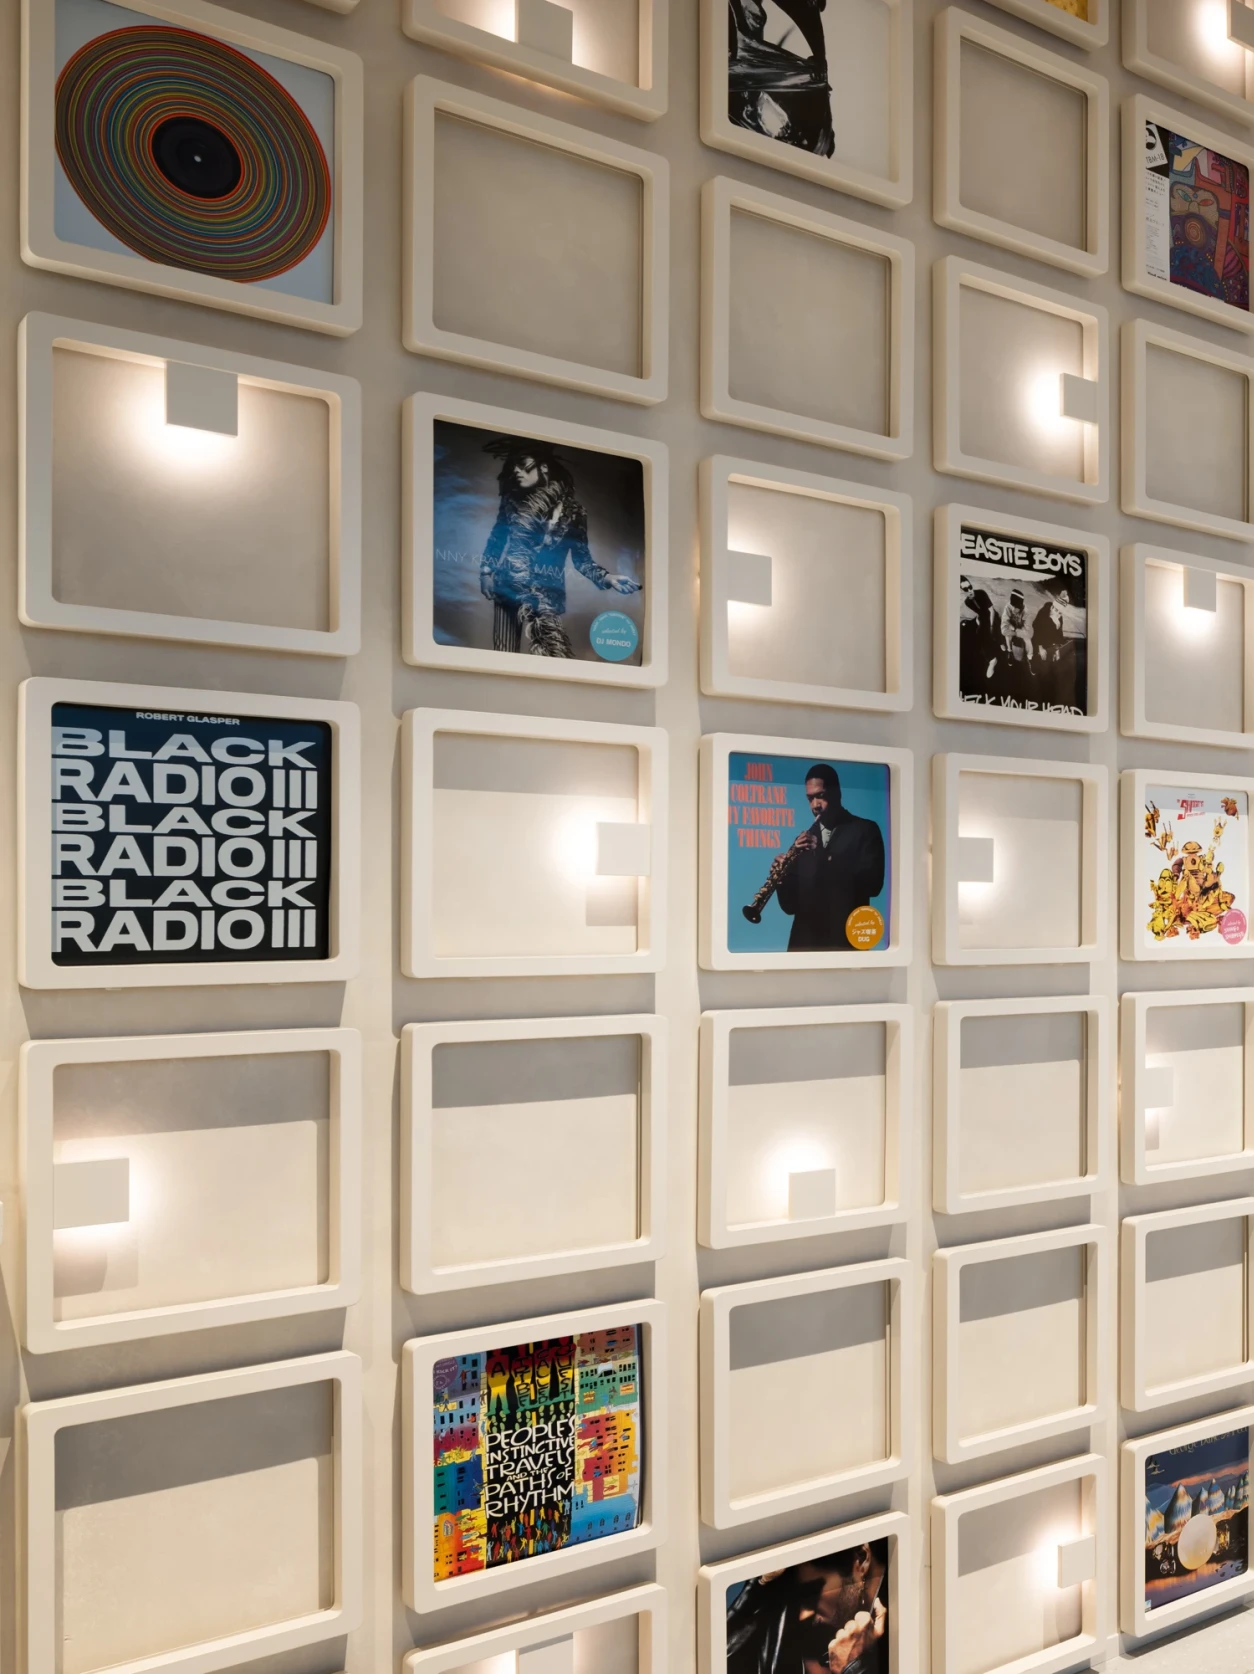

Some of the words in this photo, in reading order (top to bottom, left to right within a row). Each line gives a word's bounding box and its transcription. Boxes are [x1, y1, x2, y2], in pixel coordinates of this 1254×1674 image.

[1031, 547, 1083, 577] BOYS
[596, 637, 604, 645] DJ
[606, 638, 631, 648] MONDO
[136, 711, 185, 723] ROBERT
[187, 714, 241, 727] GLASPER
[51, 726, 317, 769] BLACK
[51, 758, 266, 808] RADIO
[272, 769, 318, 810] III
[744, 762, 773, 782] JOHN
[730, 783, 787, 806] COLTRANE
[51, 802, 317, 838] BLACK
[743, 806, 795, 828] FAVORITE
[737, 828, 781, 849] THINGS
[51, 833, 266, 878] RADIO
[272, 839, 317, 879] III
[51, 879, 317, 908] BLACK
[51, 910, 266, 953] RADIO
[271, 909, 316, 948] III
[491, 1362, 506, 1378] A
[485, 1413, 576, 1452] PEOPLE'S
[485, 1447, 575, 1480] TRAVELS
[486, 1436, 575, 1465] INSTINCTIVE
[485, 1467, 557, 1501] PATHS
[506, 1471, 528, 1481] AND
[529, 1466, 550, 1477] THE
[485, 1480, 575, 1519] RHYTHM
